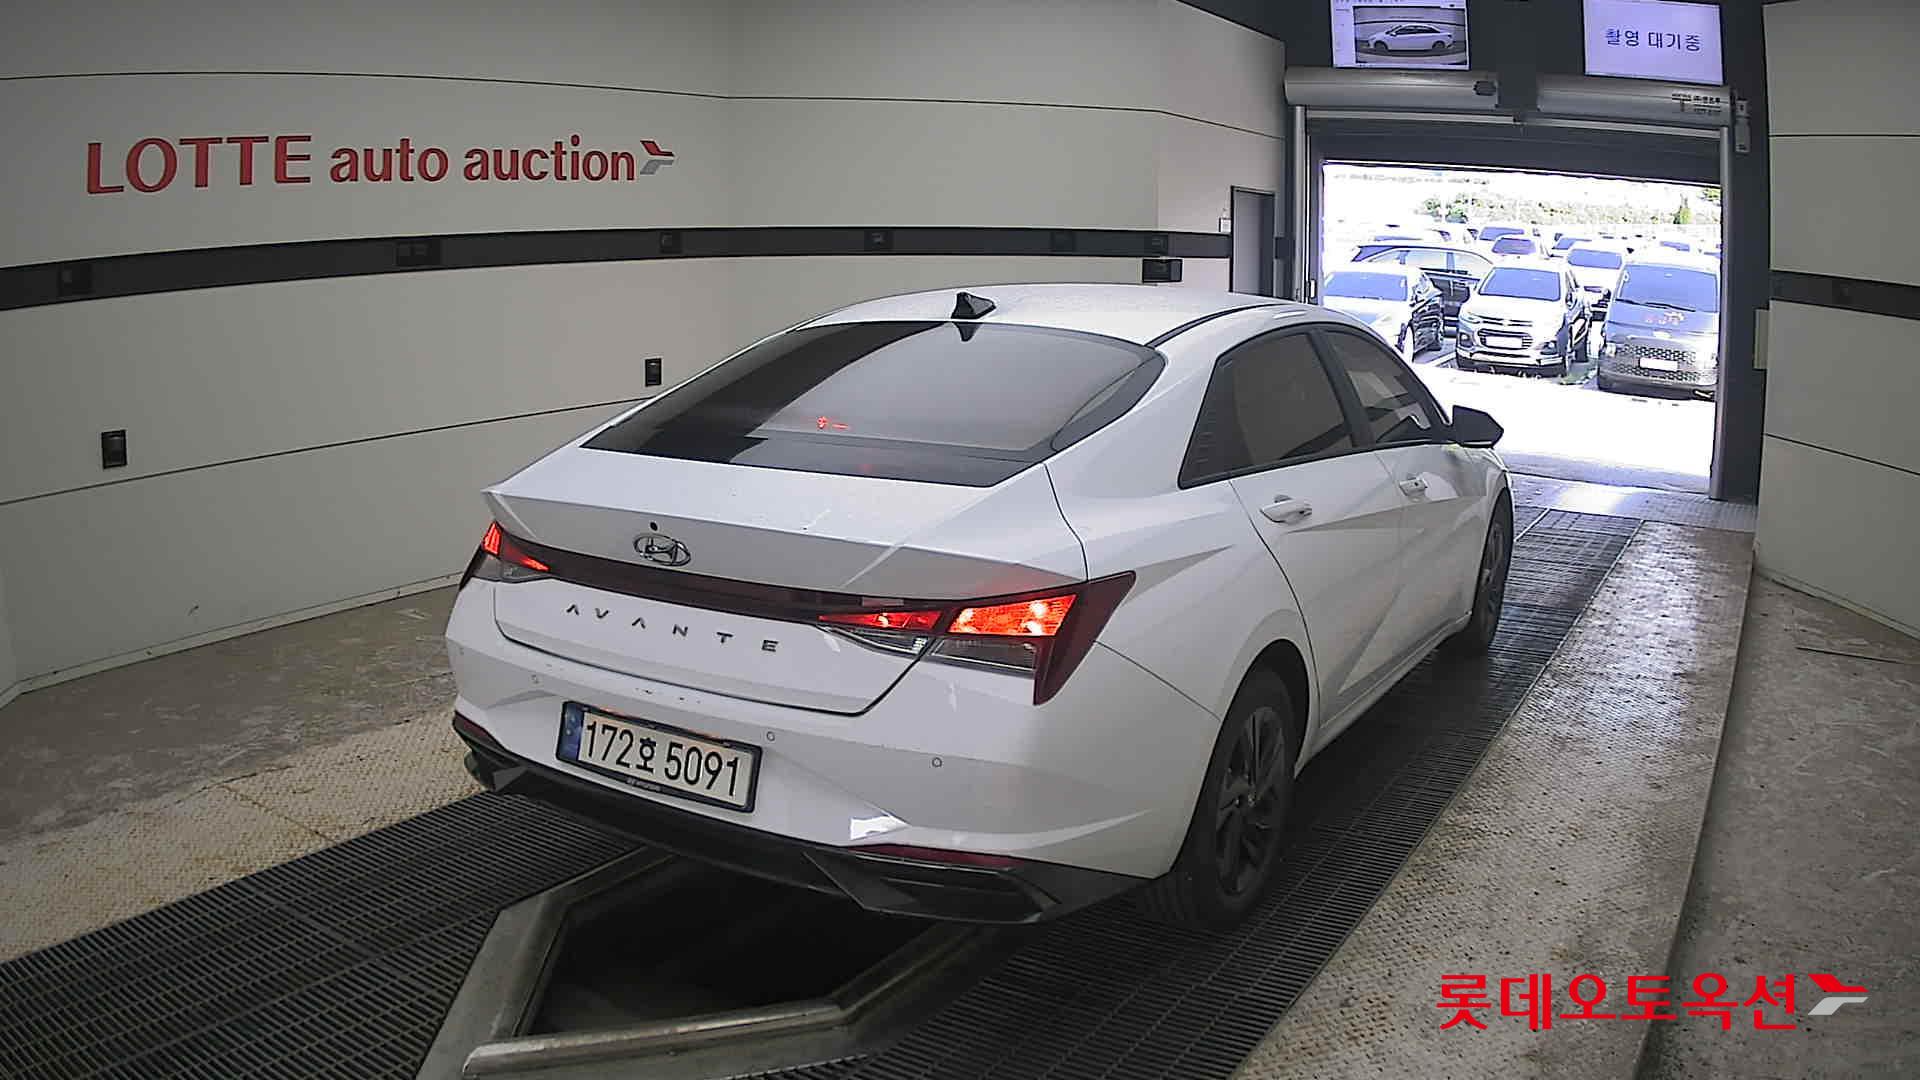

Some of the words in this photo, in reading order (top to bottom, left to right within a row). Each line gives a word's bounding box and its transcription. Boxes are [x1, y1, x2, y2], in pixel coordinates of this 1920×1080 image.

[1605, 28, 1640, 47] 촬영
[1648, 31, 1700, 52] 대기중
[86, 135, 312, 194] LOTTE
[330, 137, 449, 182] auto
[463, 134, 636, 181] auction
[566, 603, 779, 652] AVANTE
[586, 720, 656, 774] 172호
[664, 741, 739, 797] 5091
